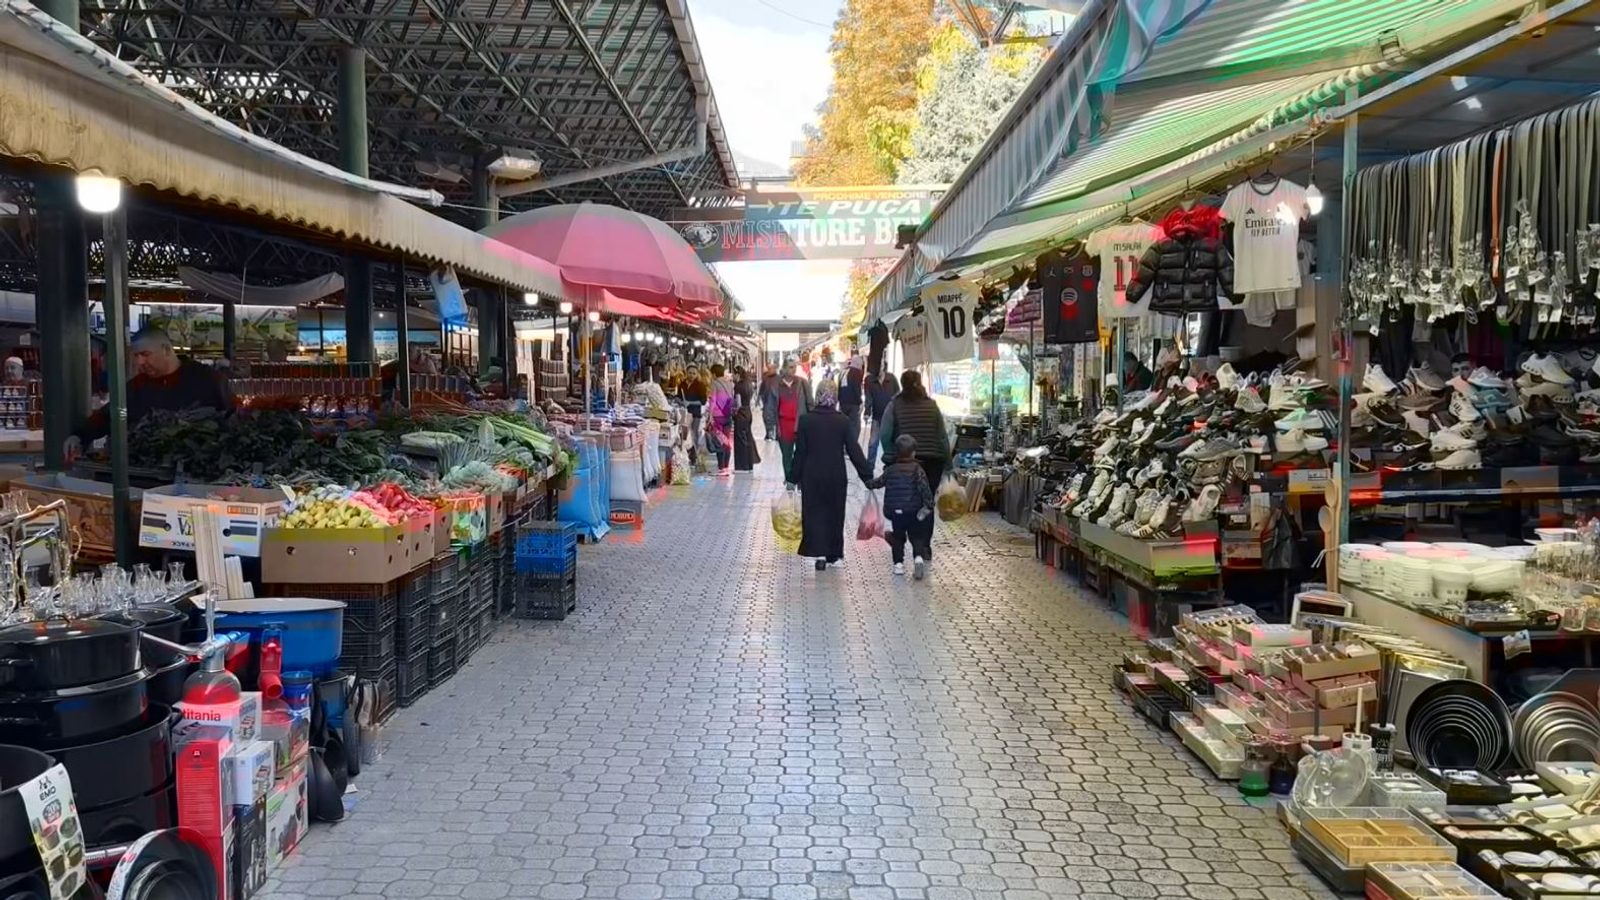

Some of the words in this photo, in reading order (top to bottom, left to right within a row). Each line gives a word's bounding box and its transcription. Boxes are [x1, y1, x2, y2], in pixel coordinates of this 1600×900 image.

[779, 201, 820, 216] TE
[721, 218, 867, 250] MISHTORE
[1113, 255, 1139, 292] 11
[938, 305, 966, 340] 10
[181, 709, 222, 721] titania
[39, 785, 57, 802] EMO
